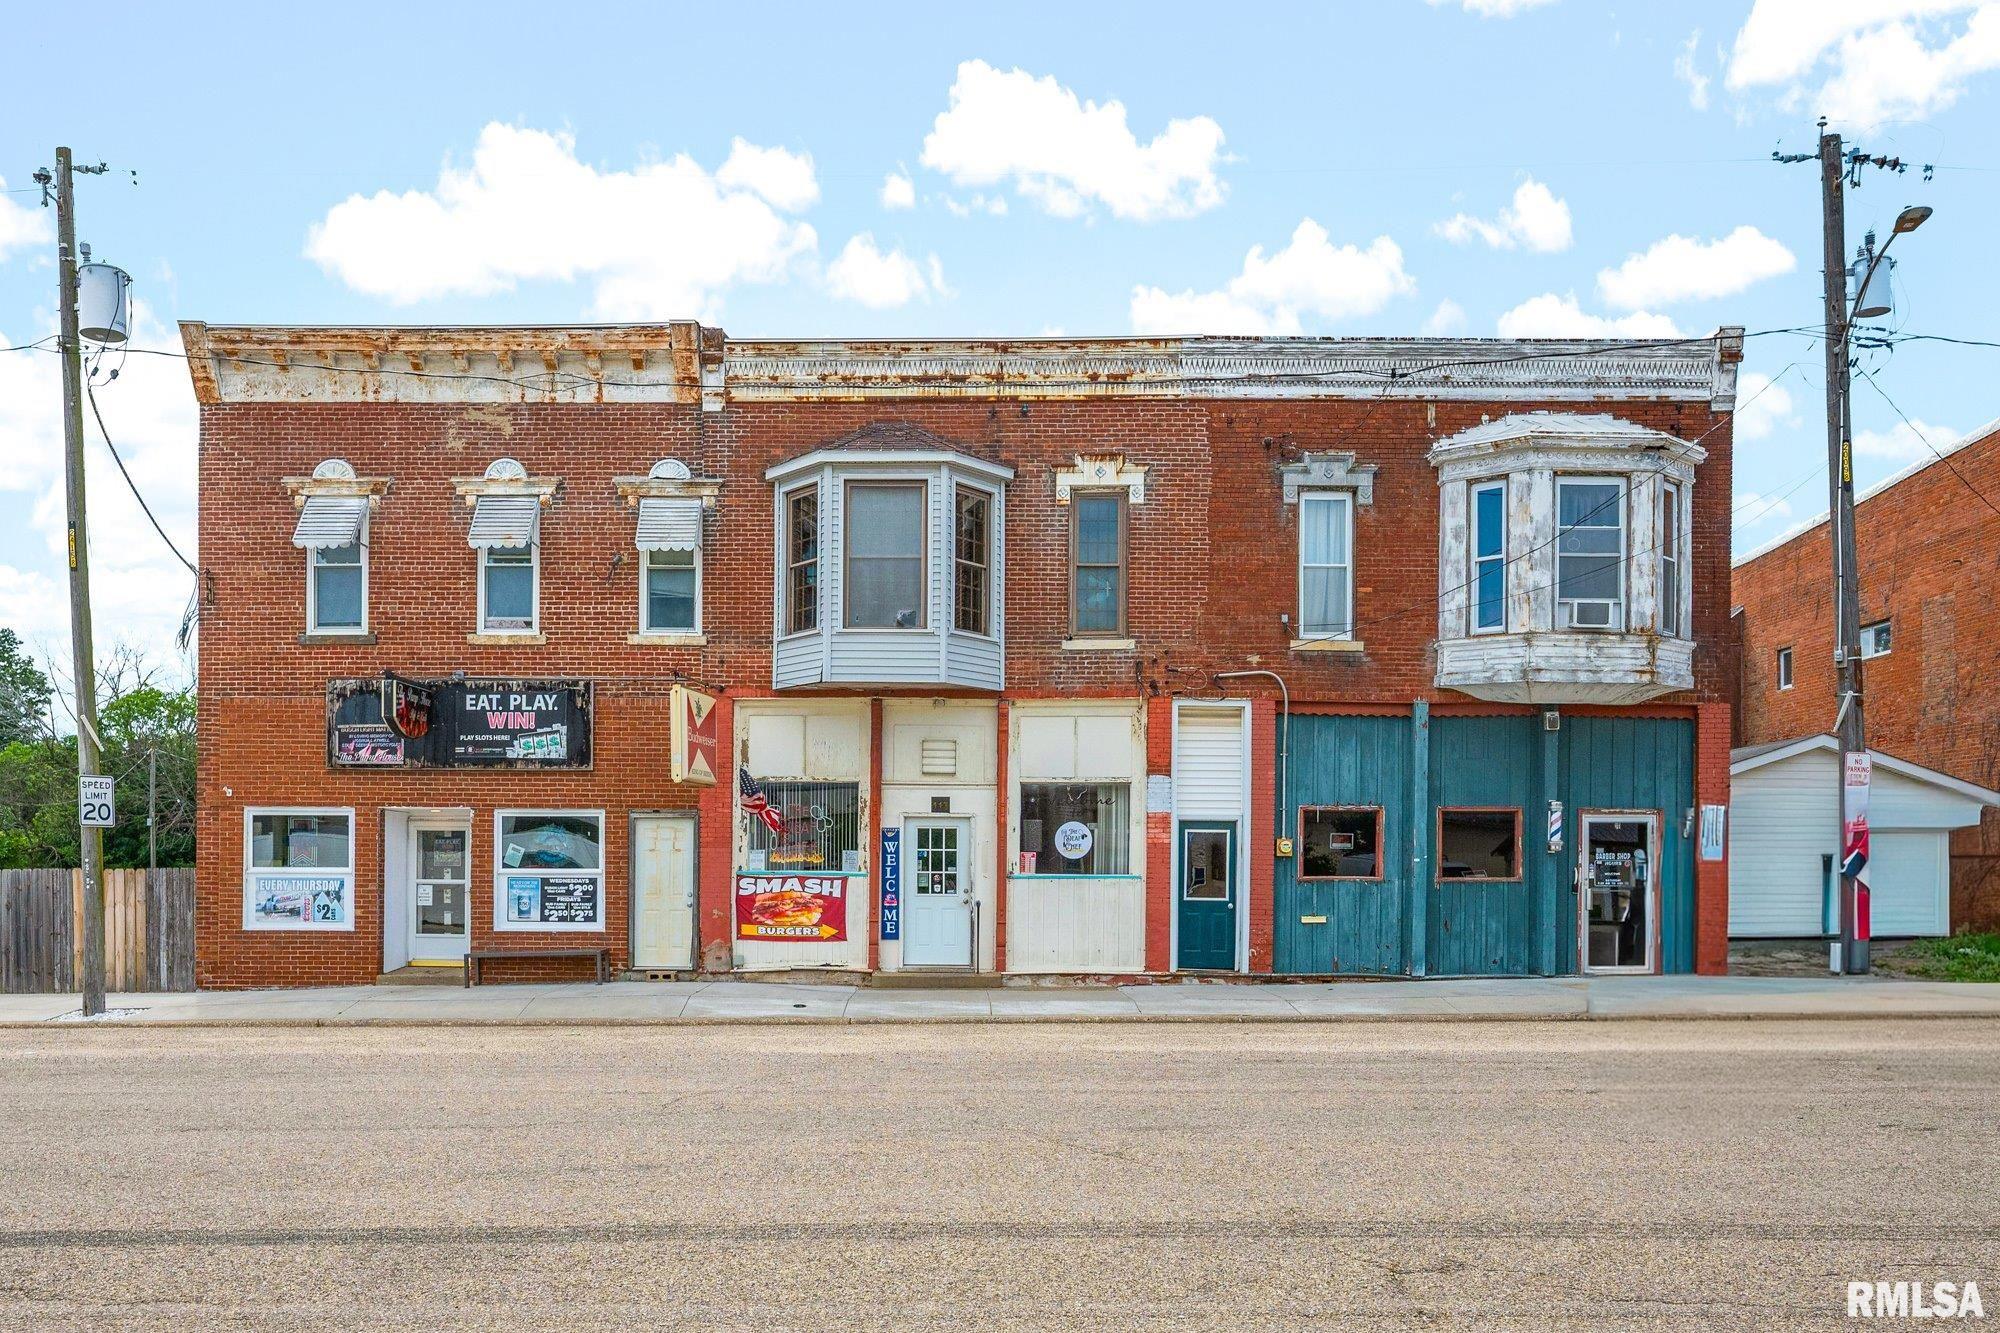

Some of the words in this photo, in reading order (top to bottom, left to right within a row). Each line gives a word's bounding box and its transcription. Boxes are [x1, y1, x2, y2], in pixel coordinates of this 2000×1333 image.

[465, 694, 503, 711] EAT.
[509, 694, 558, 711] PLAY.
[486, 711, 536, 729] WIN!
[687, 726, 716, 747] Budweiser
[1854, 758, 1863, 766] NO
[1847, 766, 1870, 774] PARKING
[82, 781, 111, 790] SPEED
[85, 792, 108, 800] LIMIT
[83, 803, 111, 821] 20
[260, 879, 289, 891] EVERY
[291, 879, 341, 891] THURSDAY
[739, 877, 842, 898] SMASH
[316, 903, 331, 920] $2
[757, 926, 820, 936] BURGERS
